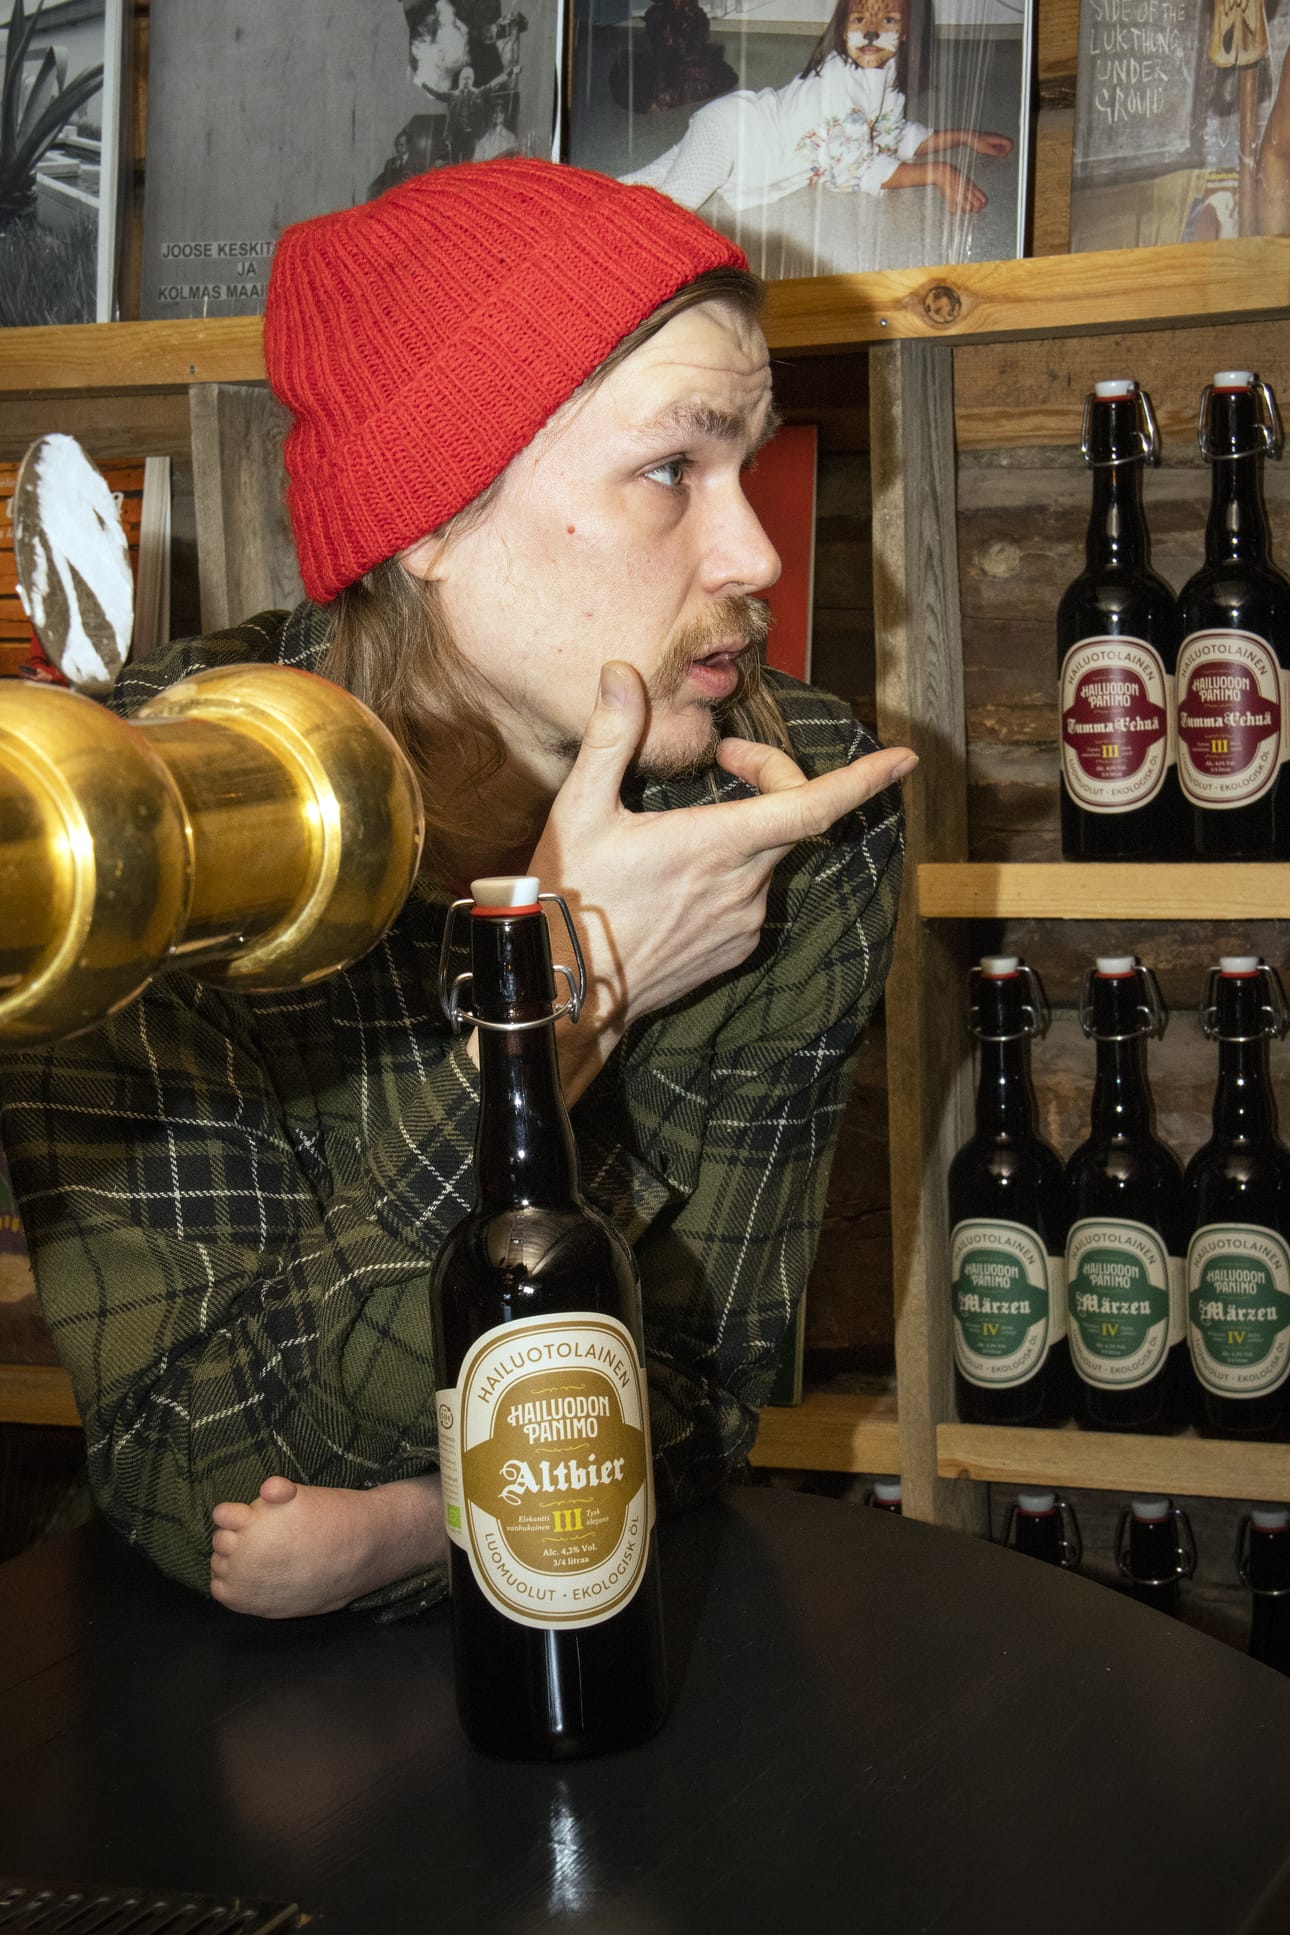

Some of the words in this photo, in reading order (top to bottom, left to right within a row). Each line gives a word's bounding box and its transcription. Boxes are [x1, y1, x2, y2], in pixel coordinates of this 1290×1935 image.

[1137, 0, 1158, 22] OF
[1162, 3, 1184, 21] THE
[1097, 58, 1168, 84] UNDER
[163, 243, 213, 258] JOOSE
[237, 262, 257, 277] JA
[159, 285, 221, 300] KOLMAS
[226, 284, 265, 298] MAAI
[1067, 650, 1156, 685] HAILUOTOLAINEN
[1182, 644, 1268, 678] HAILUOTOLAINEN
[1081, 682, 1139, 698] HAILUODON
[1192, 676, 1250, 691] HAILUODON
[1088, 694, 1131, 708] PANIMO
[1199, 689, 1241, 703] PANIMO
[1068, 718, 1114, 734] Tumma
[1102, 744, 1119, 758] III
[1211, 740, 1228, 753] III
[1193, 1239, 1282, 1270] HAILUOTOLAINEN
[964, 1262, 1019, 1279] HAILUODON
[1083, 1262, 1139, 1279] HAILUODON
[1206, 1269, 1265, 1285] HAILUODON
[971, 1274, 1011, 1289] PANIMO
[1089, 1274, 1131, 1289] PANIMO
[1214, 1281, 1257, 1295] PANIMO
[982, 1322, 1000, 1336] IV
[1102, 1322, 1119, 1336] IV
[1227, 1330, 1247, 1345] IV
[478, 1342, 630, 1403] HAILUOTOLAINEN
[507, 1396, 610, 1426] HAILUODON
[523, 1417, 598, 1445] PANIMO
[498, 1453, 625, 1506] Altbier
[552, 1508, 584, 1533] III
[484, 1532, 556, 1602] LUOMUOLUT
[573, 1542, 636, 1601] EKOLOGISK
[630, 1517, 641, 1537] ÖL
[553, 1558, 566, 1567] 3/4
[568, 1556, 589, 1565] litraa
